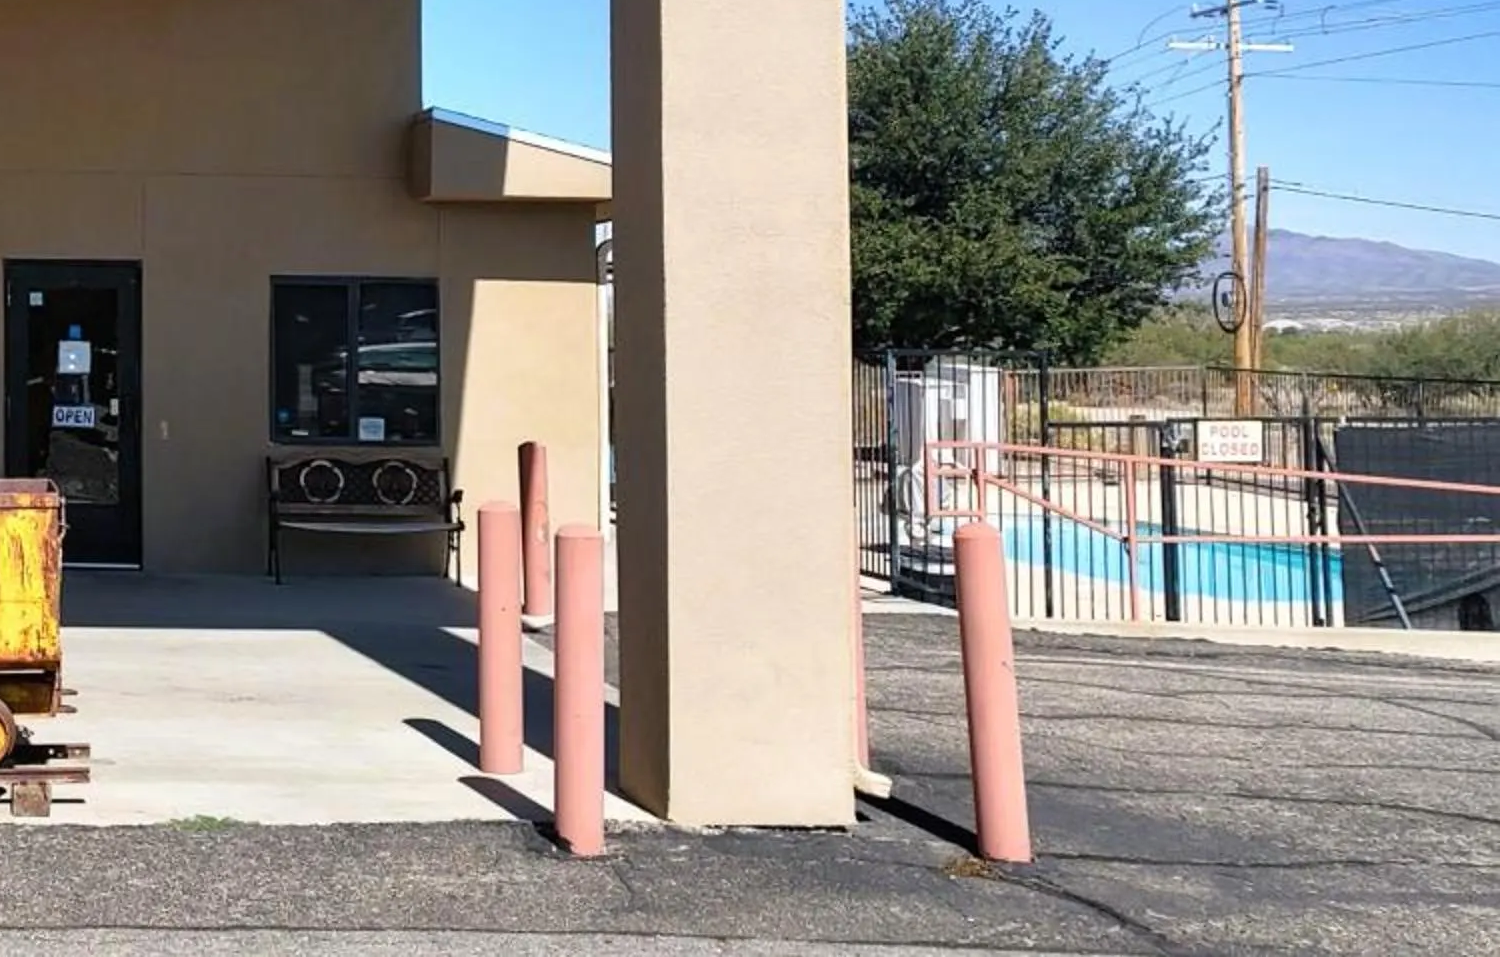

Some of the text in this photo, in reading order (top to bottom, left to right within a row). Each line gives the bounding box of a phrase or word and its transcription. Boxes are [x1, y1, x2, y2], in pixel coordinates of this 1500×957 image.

[55, 409, 93, 423] OPEN
[1209, 425, 1250, 439] POOL
[1201, 442, 1260, 456] CLOSED
